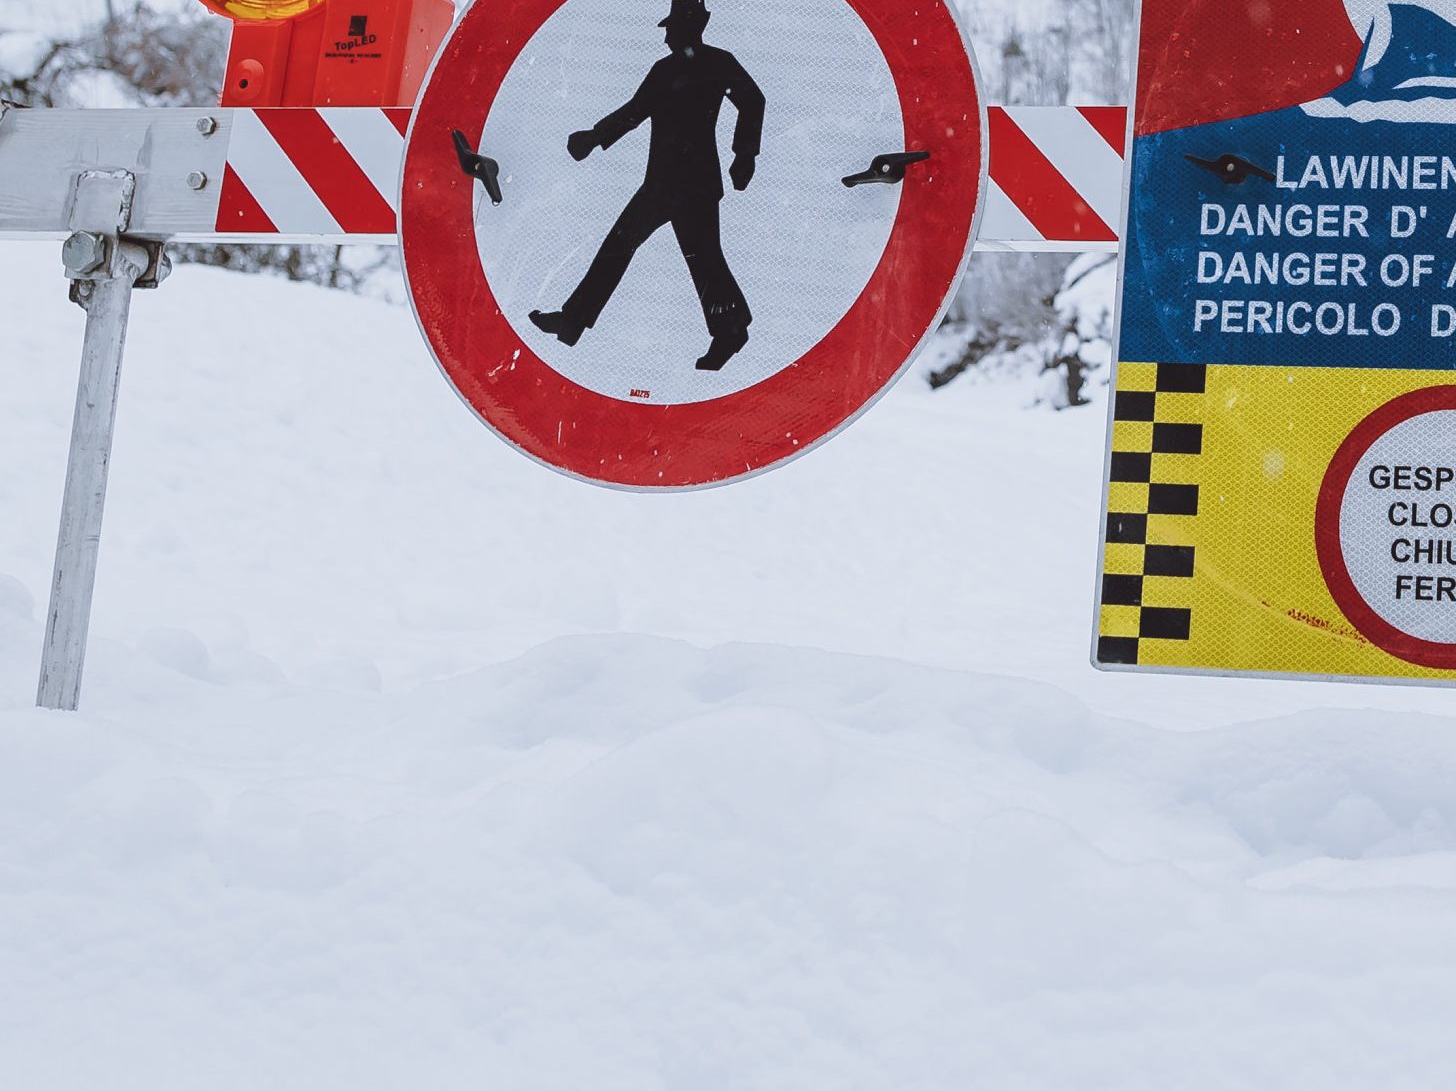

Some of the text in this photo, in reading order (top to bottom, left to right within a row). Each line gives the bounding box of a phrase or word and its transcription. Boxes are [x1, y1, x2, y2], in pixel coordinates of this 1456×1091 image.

[335, 34, 376, 51] TopLED
[1201, 204, 1369, 238] DANGER
[1391, 206, 1427, 238] D'
[1197, 251, 1367, 286] DANGER
[1380, 254, 1434, 288] OF
[1194, 299, 1401, 337] PERICOLO
